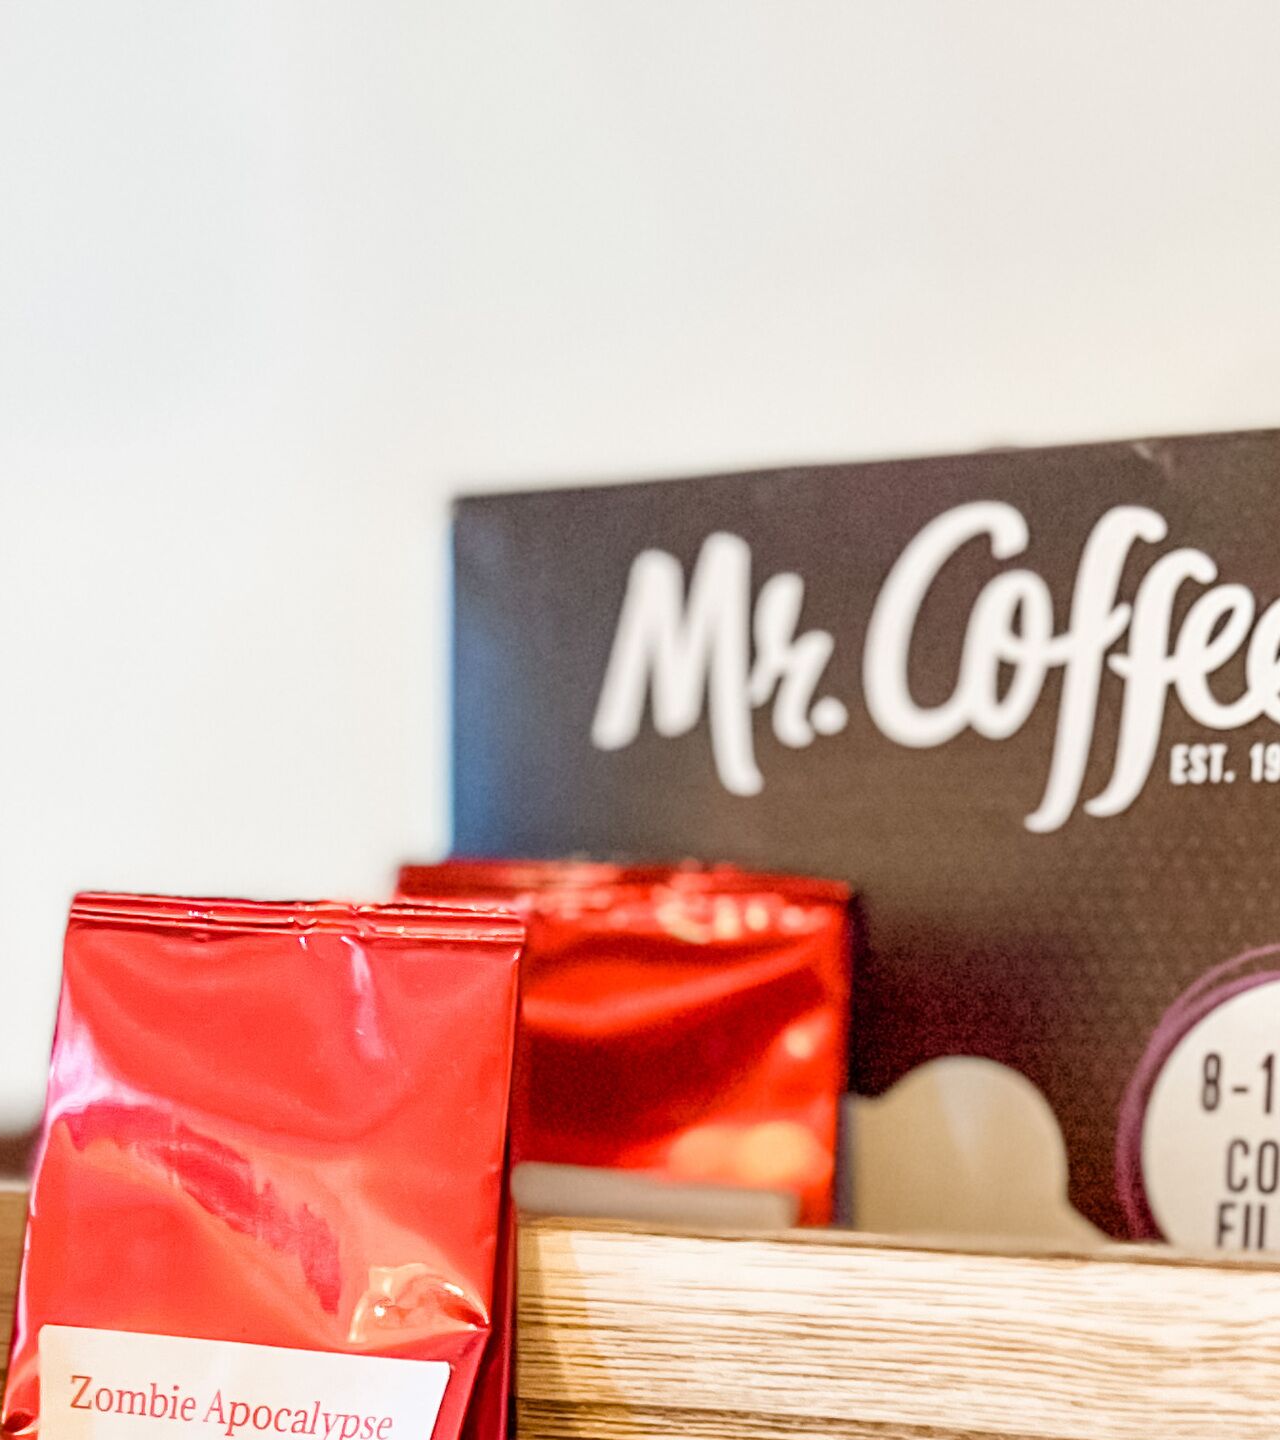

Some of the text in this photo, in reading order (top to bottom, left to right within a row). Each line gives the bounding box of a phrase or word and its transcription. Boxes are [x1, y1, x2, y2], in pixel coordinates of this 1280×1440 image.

[591, 532, 849, 797] Mr.
[1170, 743, 1237, 786] EST.
[69, 1374, 198, 1424] Zombie
